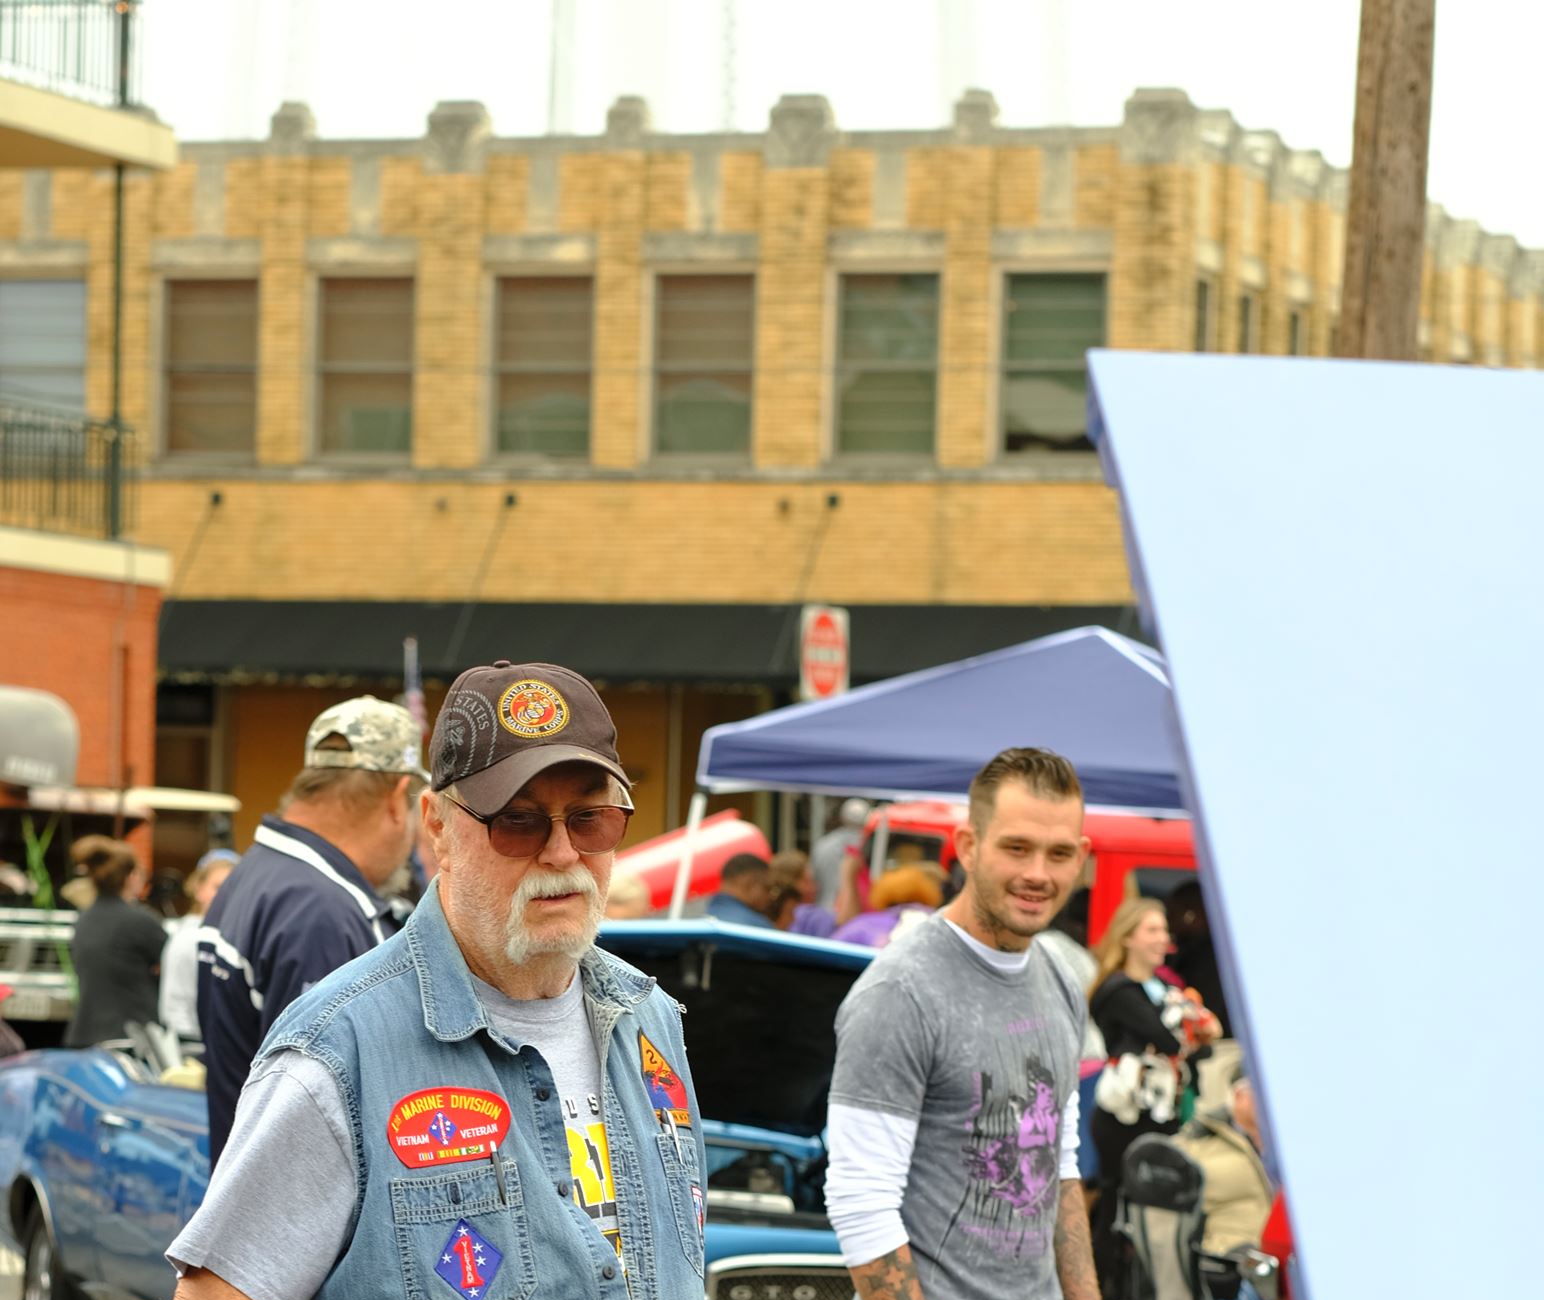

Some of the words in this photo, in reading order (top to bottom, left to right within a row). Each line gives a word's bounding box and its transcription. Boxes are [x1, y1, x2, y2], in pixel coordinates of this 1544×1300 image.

[503, 684, 527, 711] UNITED
[529, 683, 560, 706] STATES
[454, 695, 490, 731] STATES
[506, 714, 541, 734] MARINE
[543, 708, 564, 732] CORPS
[646, 1049, 658, 1065] 2
[400, 1094, 445, 1121] MARINE
[450, 1094, 502, 1121] DIVISION
[396, 1134, 430, 1147] VIETNAM
[460, 1123, 499, 1139] VETERAN
